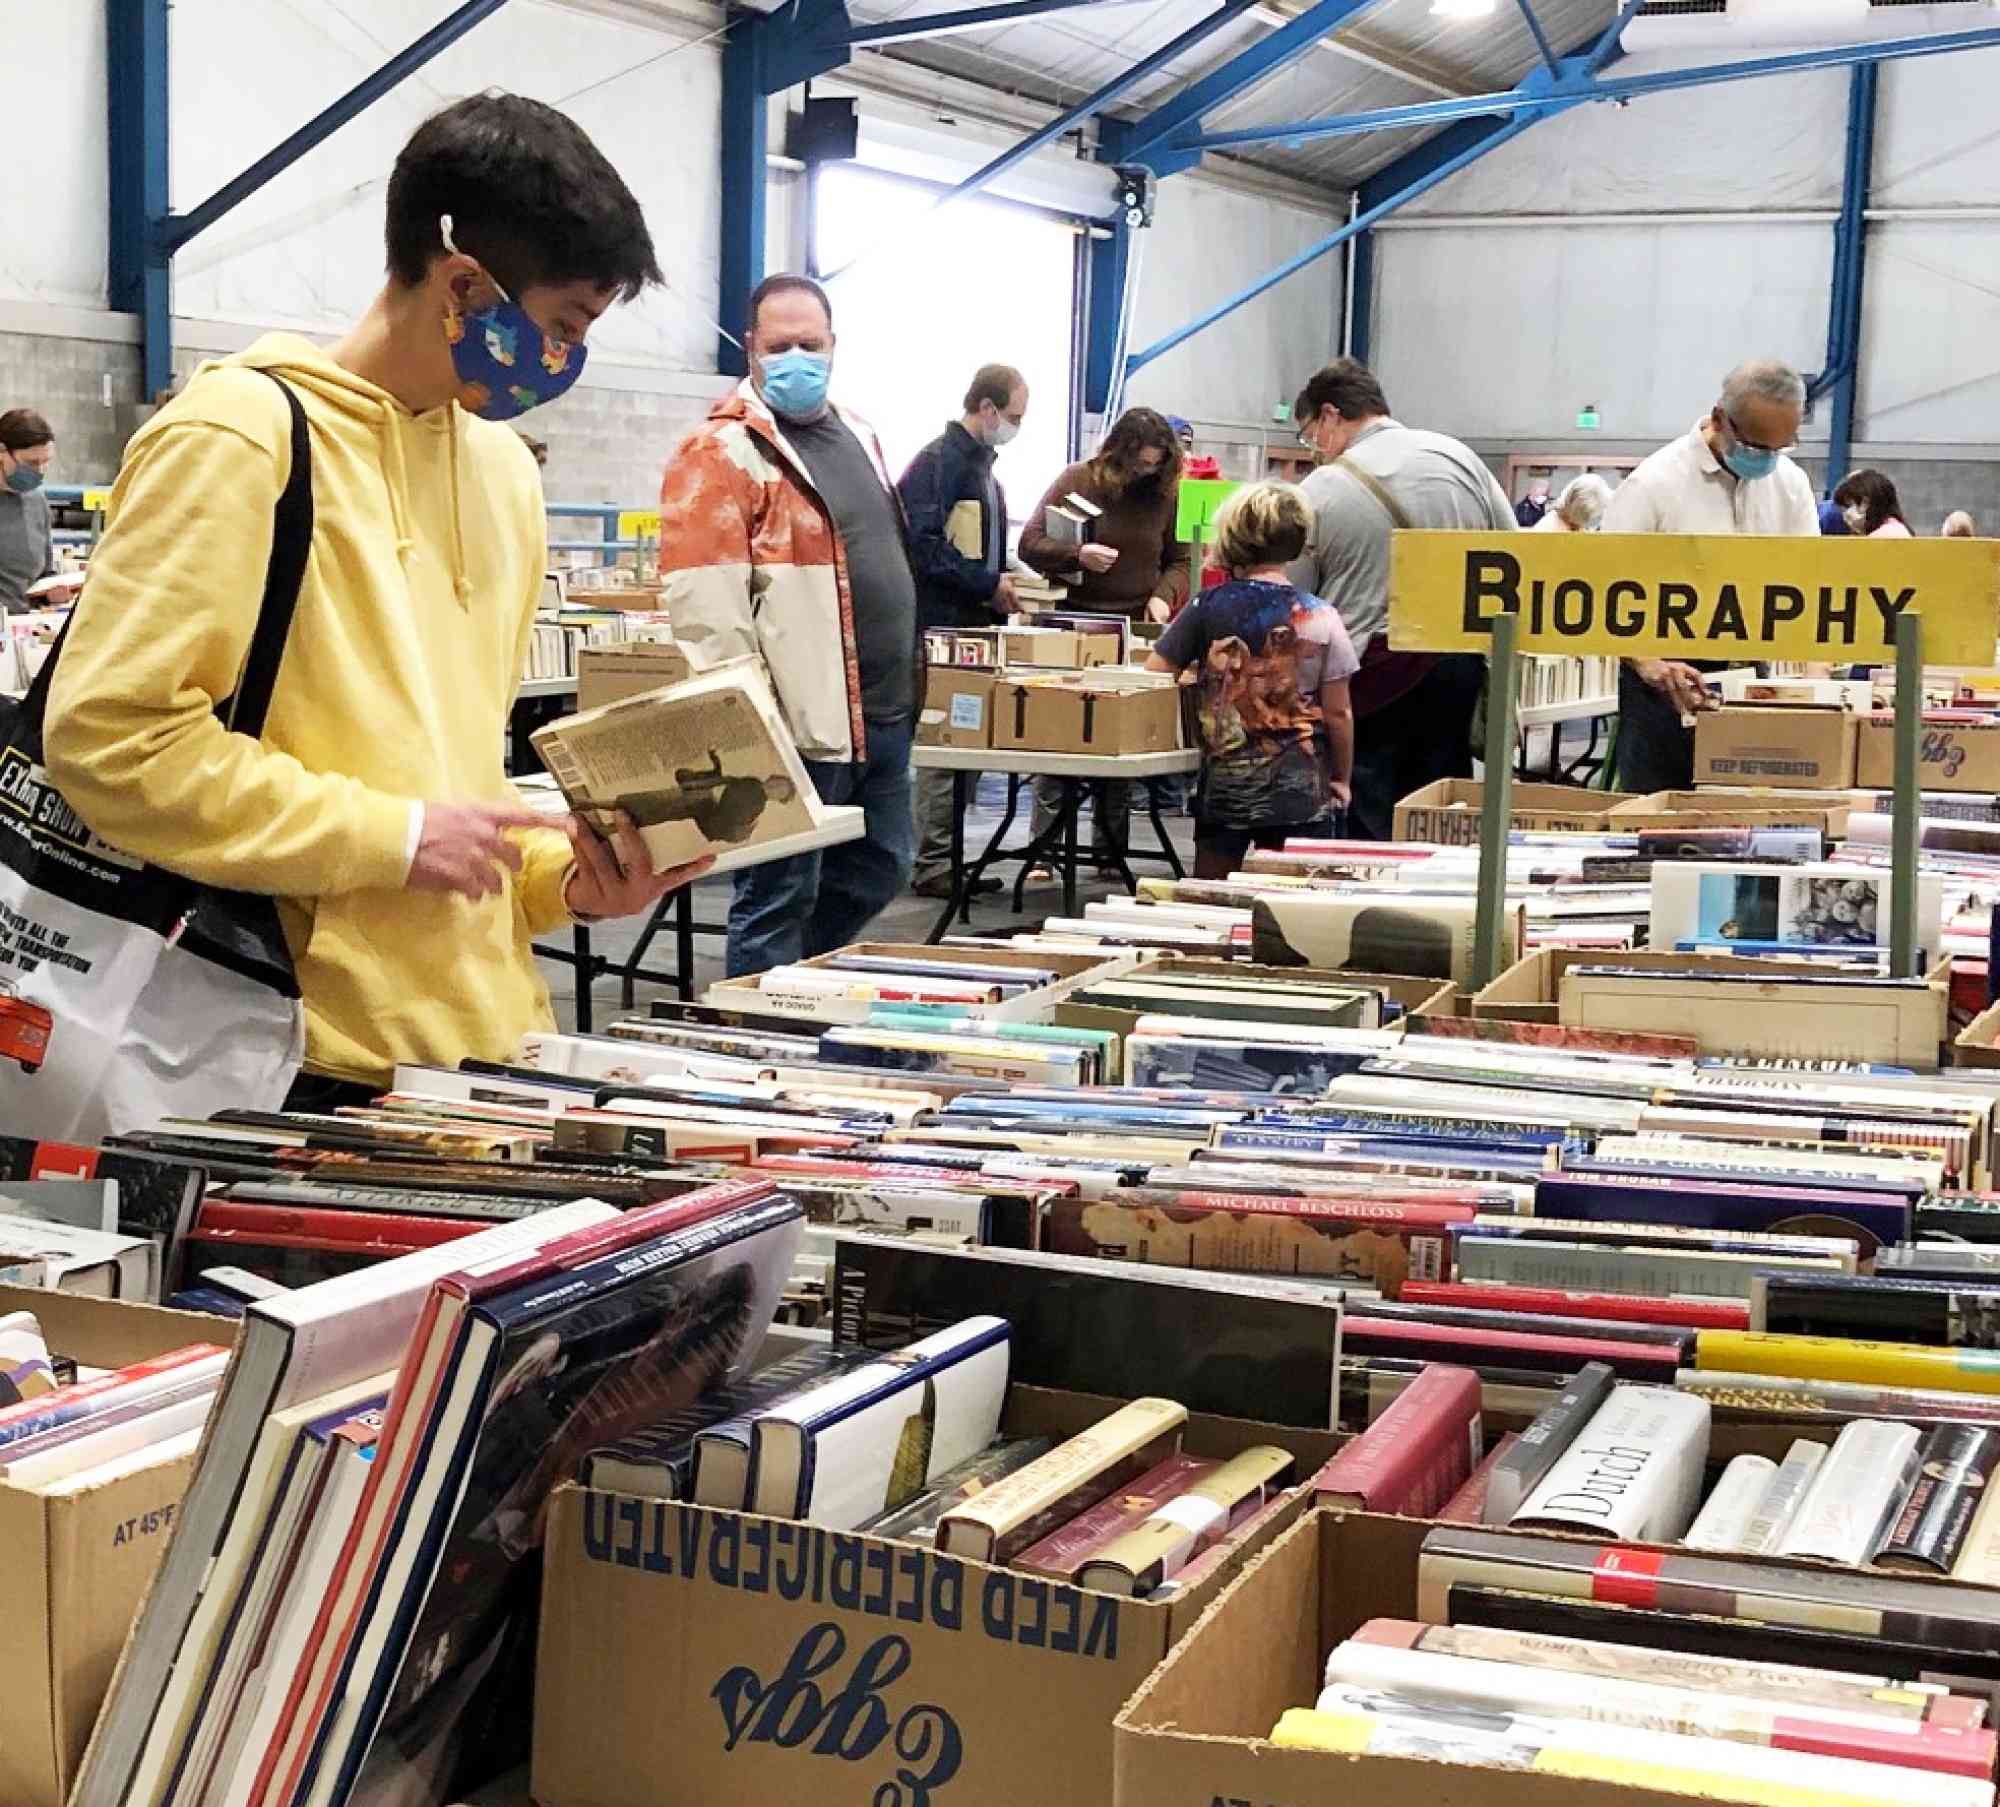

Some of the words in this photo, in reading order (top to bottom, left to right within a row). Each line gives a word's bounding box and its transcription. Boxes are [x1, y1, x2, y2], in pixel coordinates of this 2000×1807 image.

[1465, 552, 1917, 643] BIOGRAPHY
[1206, 1196, 1290, 1213] MICHAEL
[1298, 1203, 1406, 1219] BESCHLOSS
[1542, 1446, 1651, 1518] Dutch
[113, 1518, 137, 1547] AT
[711, 1621, 966, 1807] Eggs
